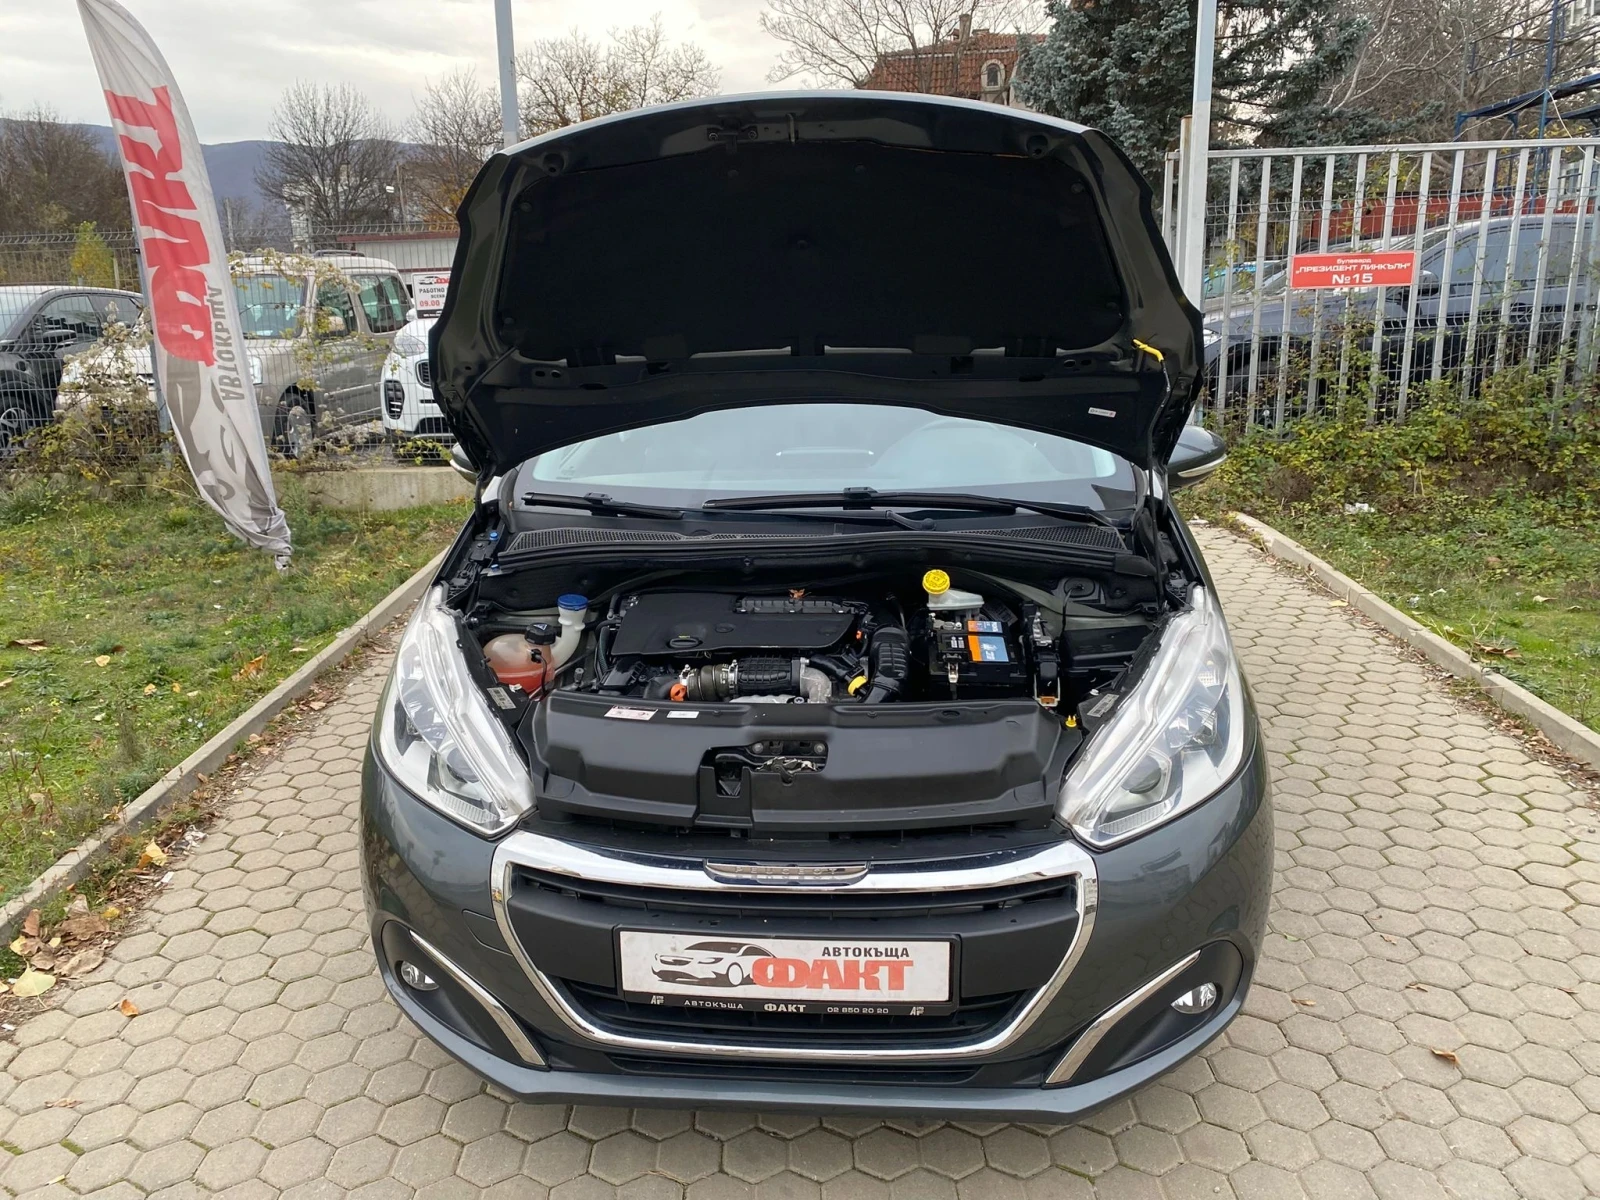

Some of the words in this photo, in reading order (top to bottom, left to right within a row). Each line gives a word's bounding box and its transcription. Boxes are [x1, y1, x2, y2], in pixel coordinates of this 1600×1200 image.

[821, 946, 910, 959] АВТОКЪЩА
[752, 957, 914, 991] ФАКТ
[763, 1003, 806, 1013] ФАКТ
